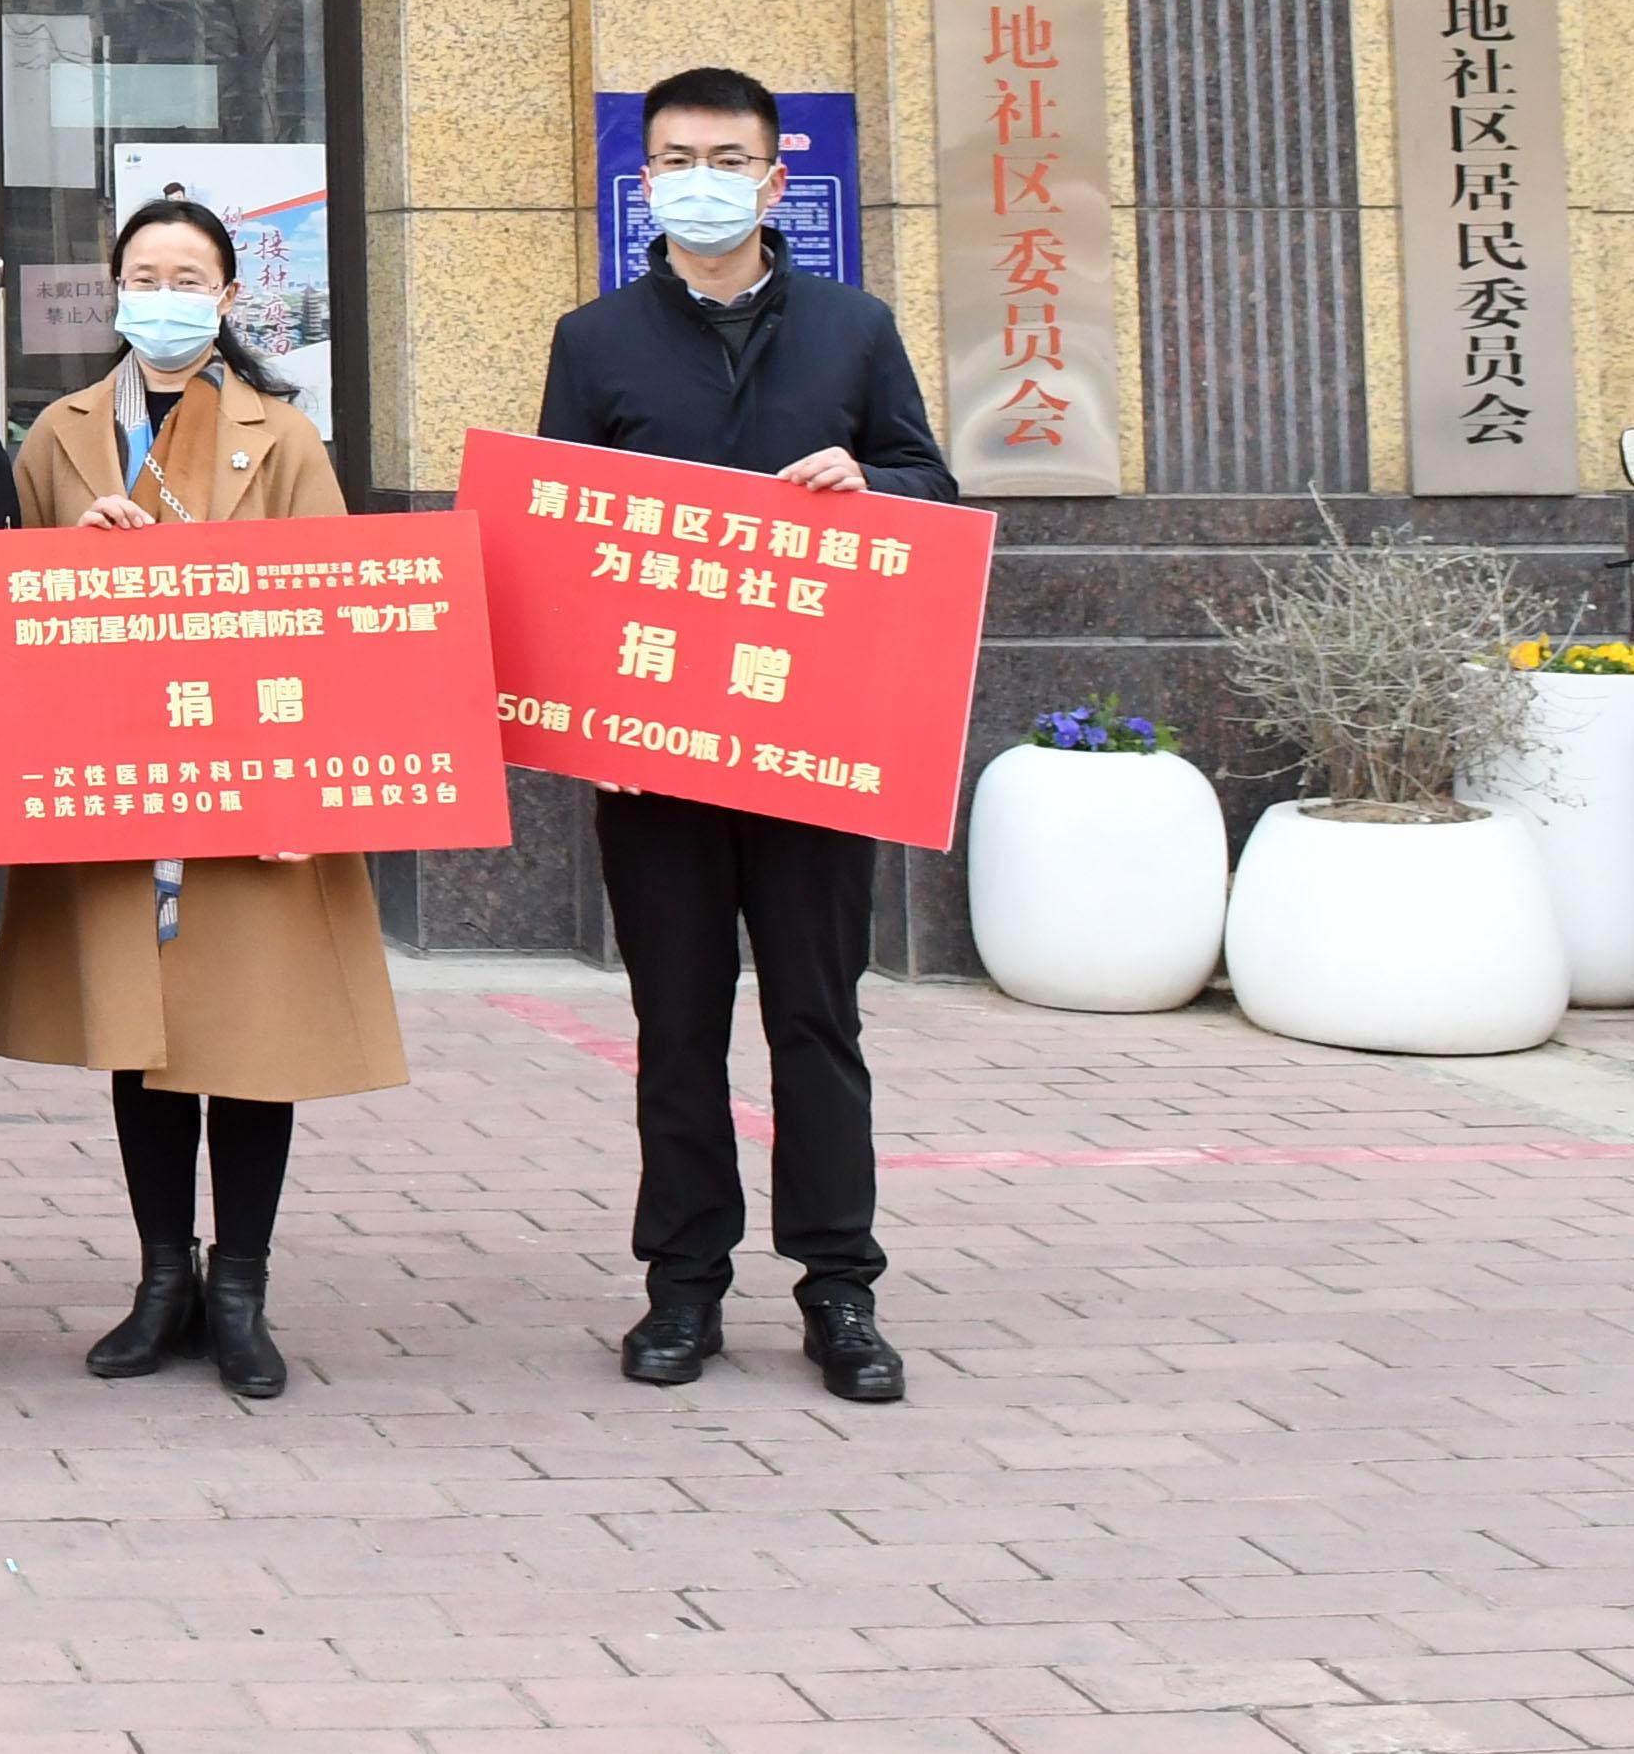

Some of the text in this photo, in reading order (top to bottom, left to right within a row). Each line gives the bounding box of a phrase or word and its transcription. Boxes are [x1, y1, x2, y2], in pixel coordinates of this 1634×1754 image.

[254, 230, 292, 356] 接种疫苗
[527, 478, 913, 577] 清江浦区万和超市
[7, 556, 444, 604] 疫情攻坚见行动 朱华林
[591, 541, 829, 617] 为绿地社区
[22, 752, 454, 787] 一次性医用外科口罩10000只
[24, 782, 458, 819] 免洗洗手液90瓶 测温仪3台
